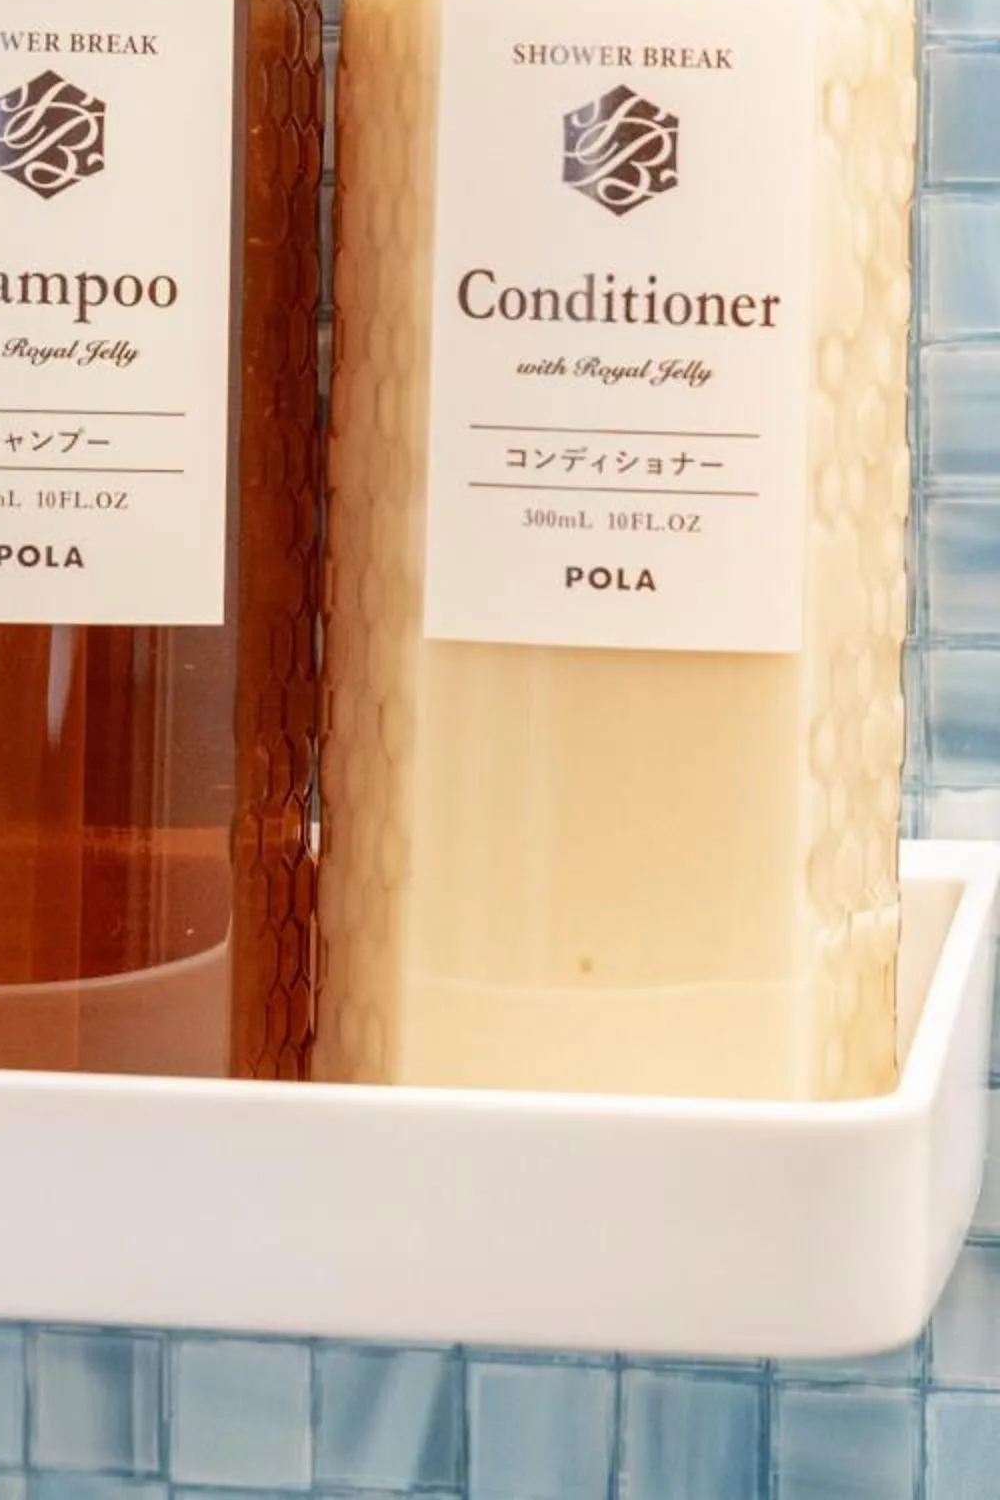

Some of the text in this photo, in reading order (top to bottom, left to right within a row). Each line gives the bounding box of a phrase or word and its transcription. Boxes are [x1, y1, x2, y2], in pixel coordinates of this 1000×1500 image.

[70, 33, 158, 55] BREAK
[513, 44, 731, 69] SHOWER BREAK
[457, 269, 780, 327] Conditioner
[2, 338, 77, 365] Royal
[77, 340, 138, 367] Jelly
[516, 356, 712, 387] with Royal Jelly
[506, 446, 724, 476] コンディショナー
[522, 508, 593, 529] 300mL
[565, 566, 656, 591] POLA
